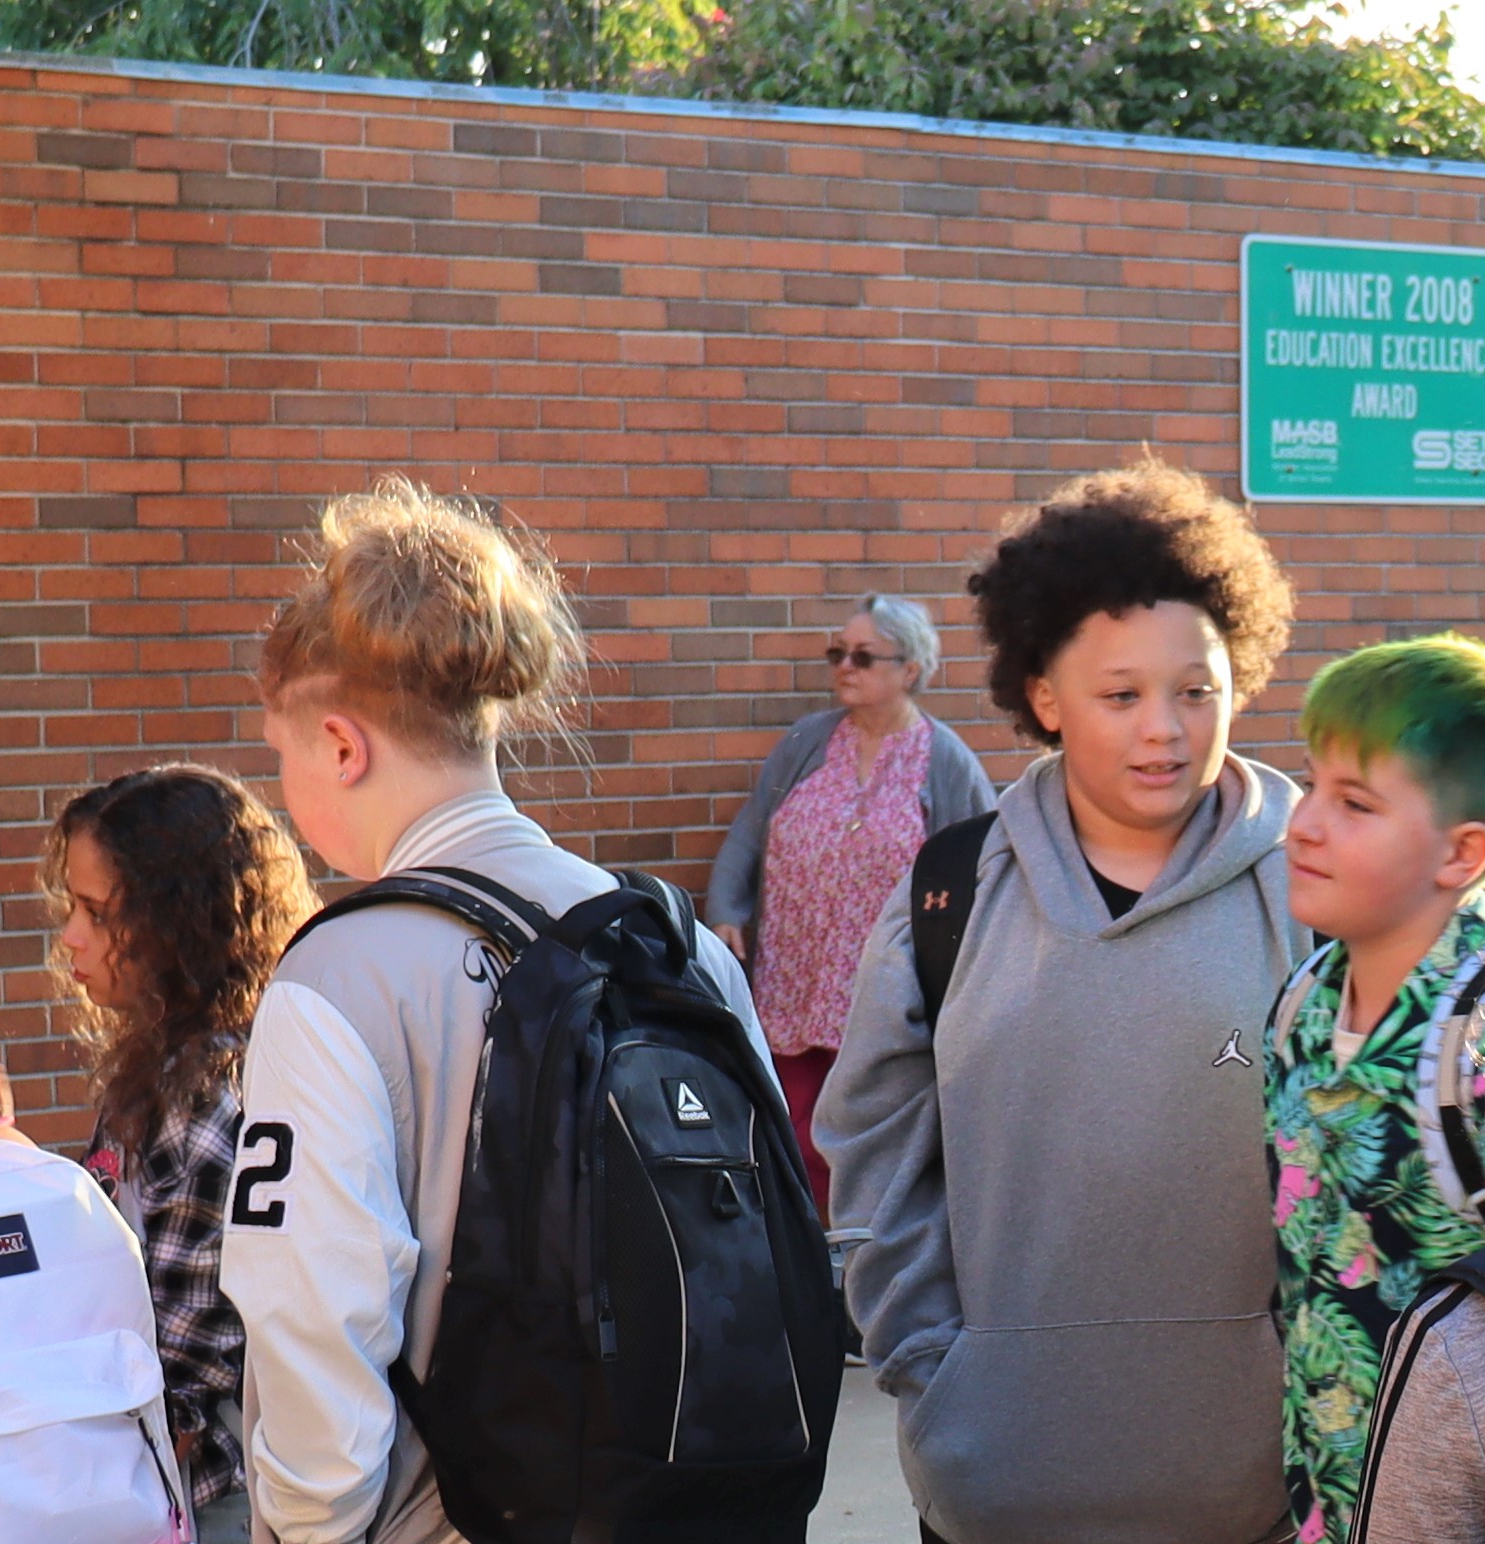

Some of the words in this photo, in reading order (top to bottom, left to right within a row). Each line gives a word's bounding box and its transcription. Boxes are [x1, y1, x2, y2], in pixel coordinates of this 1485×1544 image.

[1292, 269, 1393, 321] WINNER
[1404, 274, 1475, 327] 2008
[1266, 328, 1373, 369] EDUCATION
[1351, 382, 1418, 419] AWARD
[1271, 418, 1338, 444] MASB
[231, 1122, 294, 1228] 2
